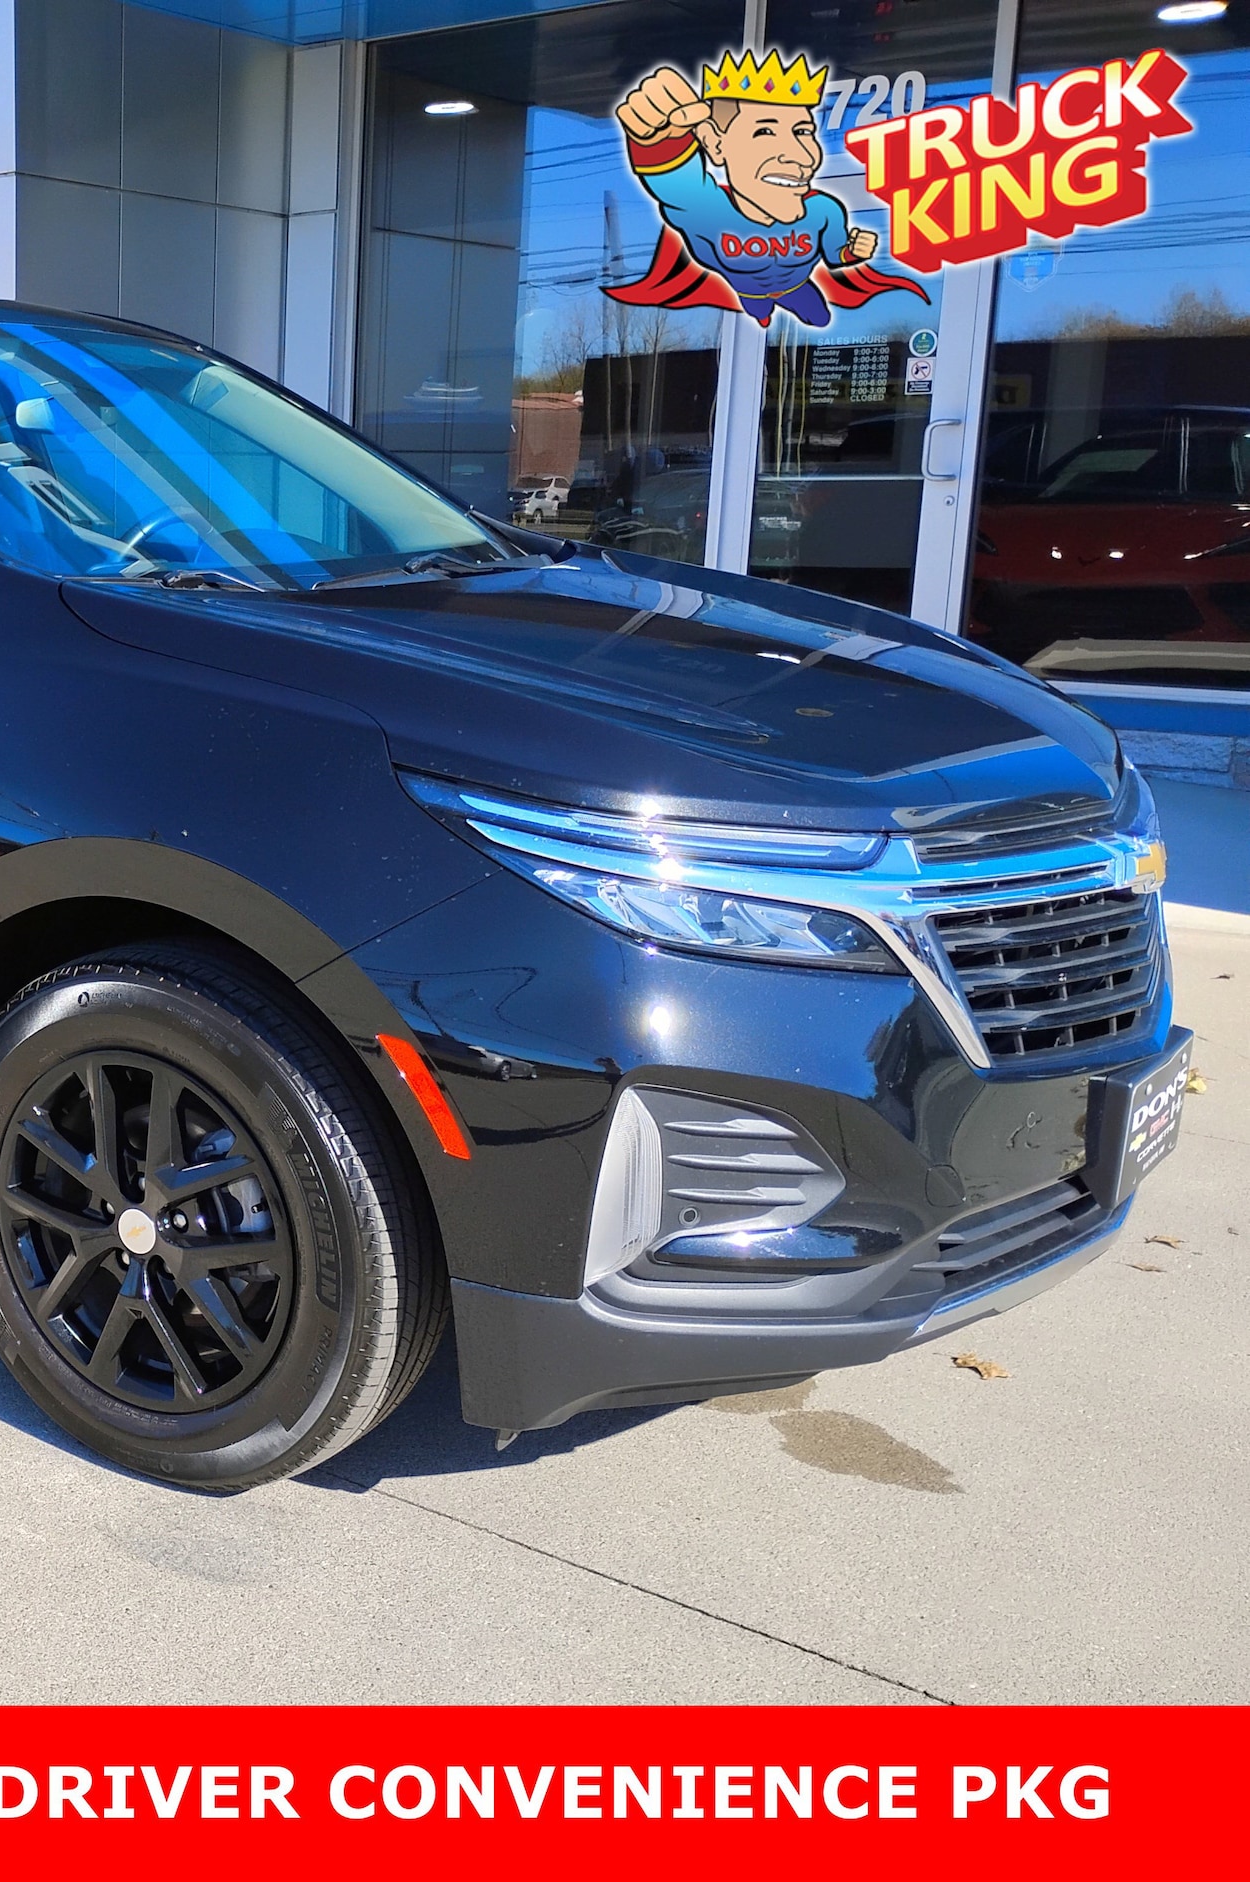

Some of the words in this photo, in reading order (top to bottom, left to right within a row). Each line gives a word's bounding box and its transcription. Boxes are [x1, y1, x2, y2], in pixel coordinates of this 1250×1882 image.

[825, 70, 927, 131] 720
[817, 336, 850, 347] SALES
[852, 334, 888, 345] HOURS
[813, 349, 840, 357] Monday
[810, 381, 832, 389] Friday
[809, 396, 834, 404] Sunday
[850, 394, 885, 402] CLOSED
[295, 1151, 339, 1306] MICHELIN
